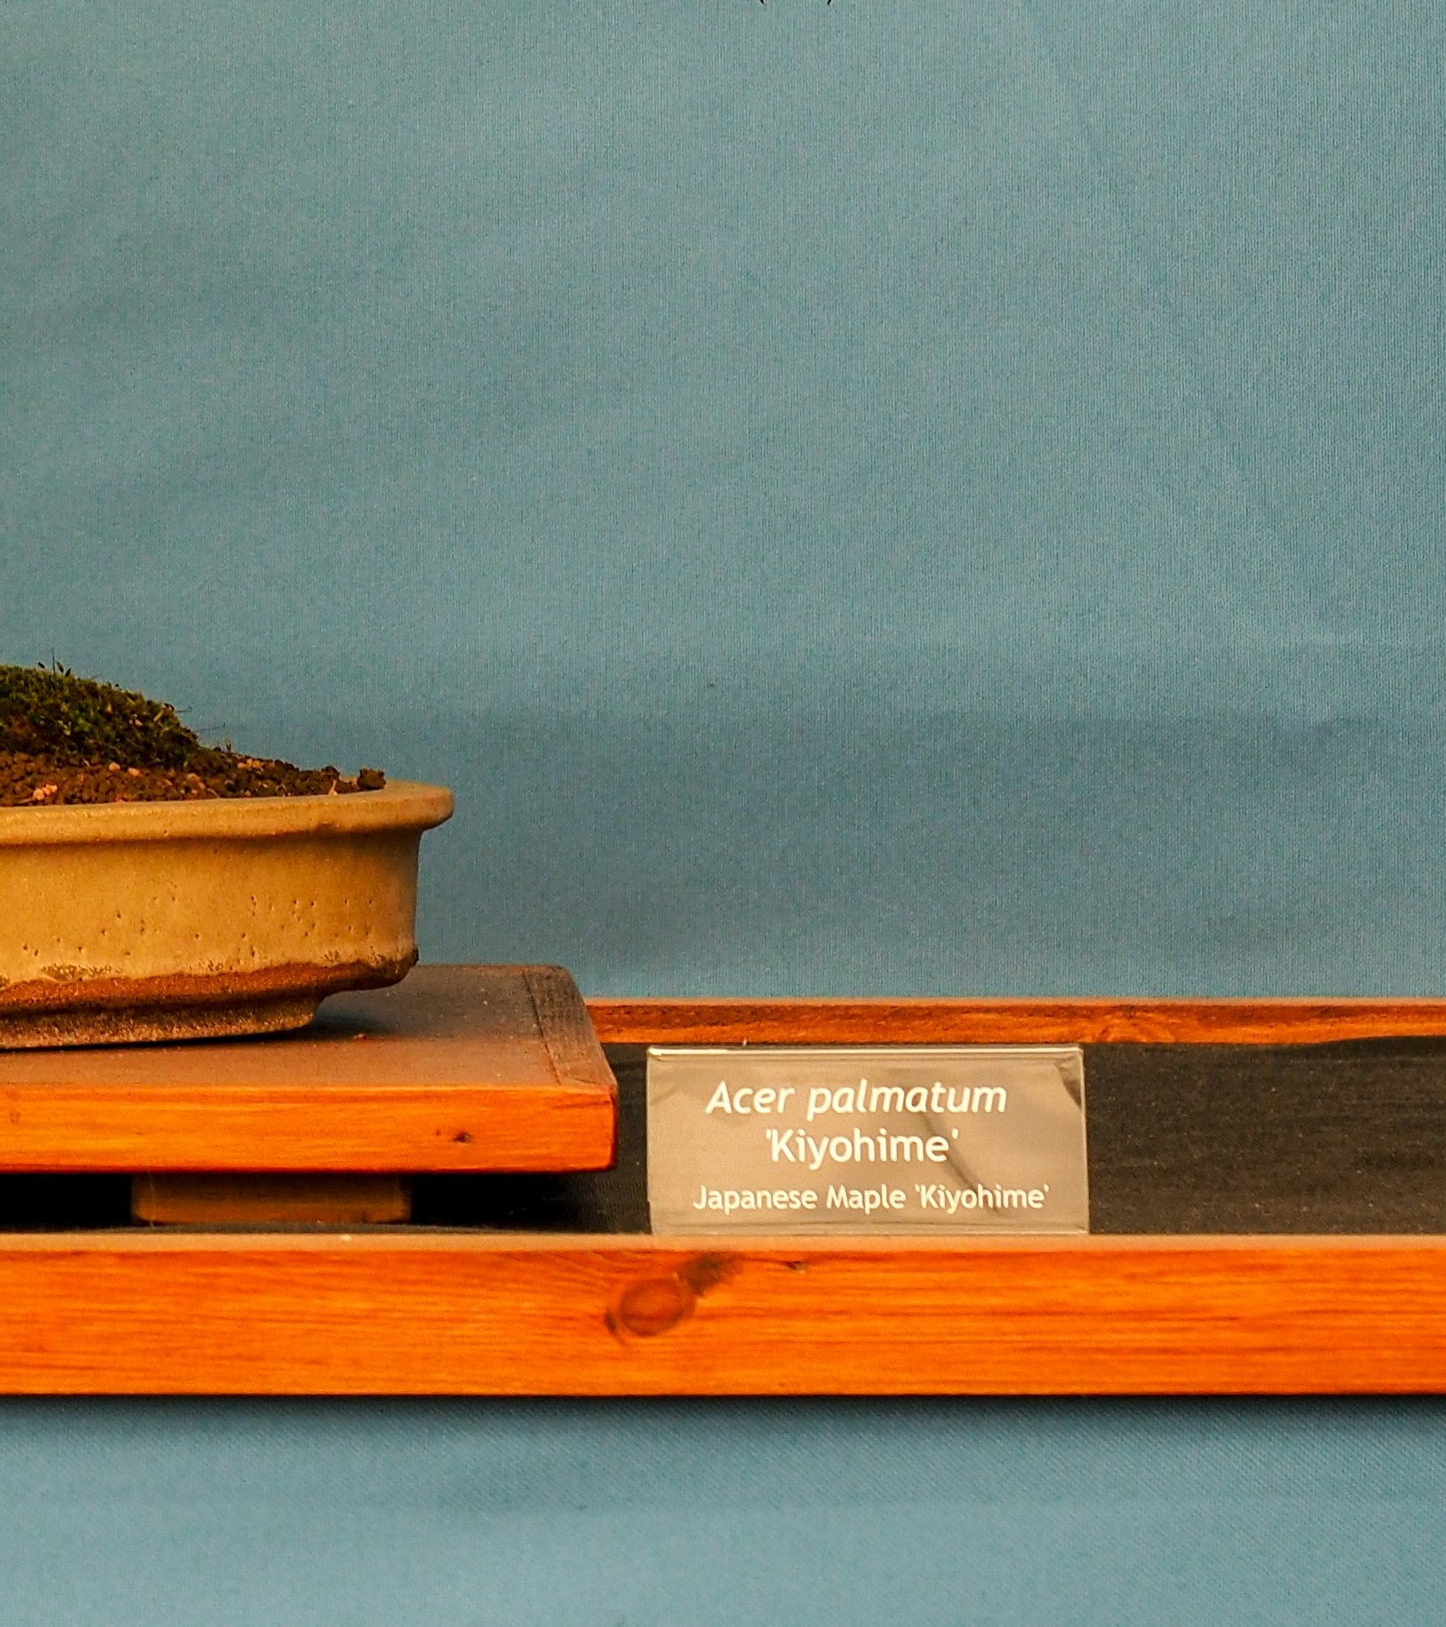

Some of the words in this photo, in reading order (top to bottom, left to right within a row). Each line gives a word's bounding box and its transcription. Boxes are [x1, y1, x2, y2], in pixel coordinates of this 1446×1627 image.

[705, 1079, 796, 1114] Acer
[806, 1077, 1007, 1122] palmatum
[765, 1127, 959, 1170] 'Kiyohime'
[692, 1184, 818, 1215] Japanese
[826, 1183, 906, 1215] Maple
[914, 1183, 1050, 1215] 'Kiyohime'
